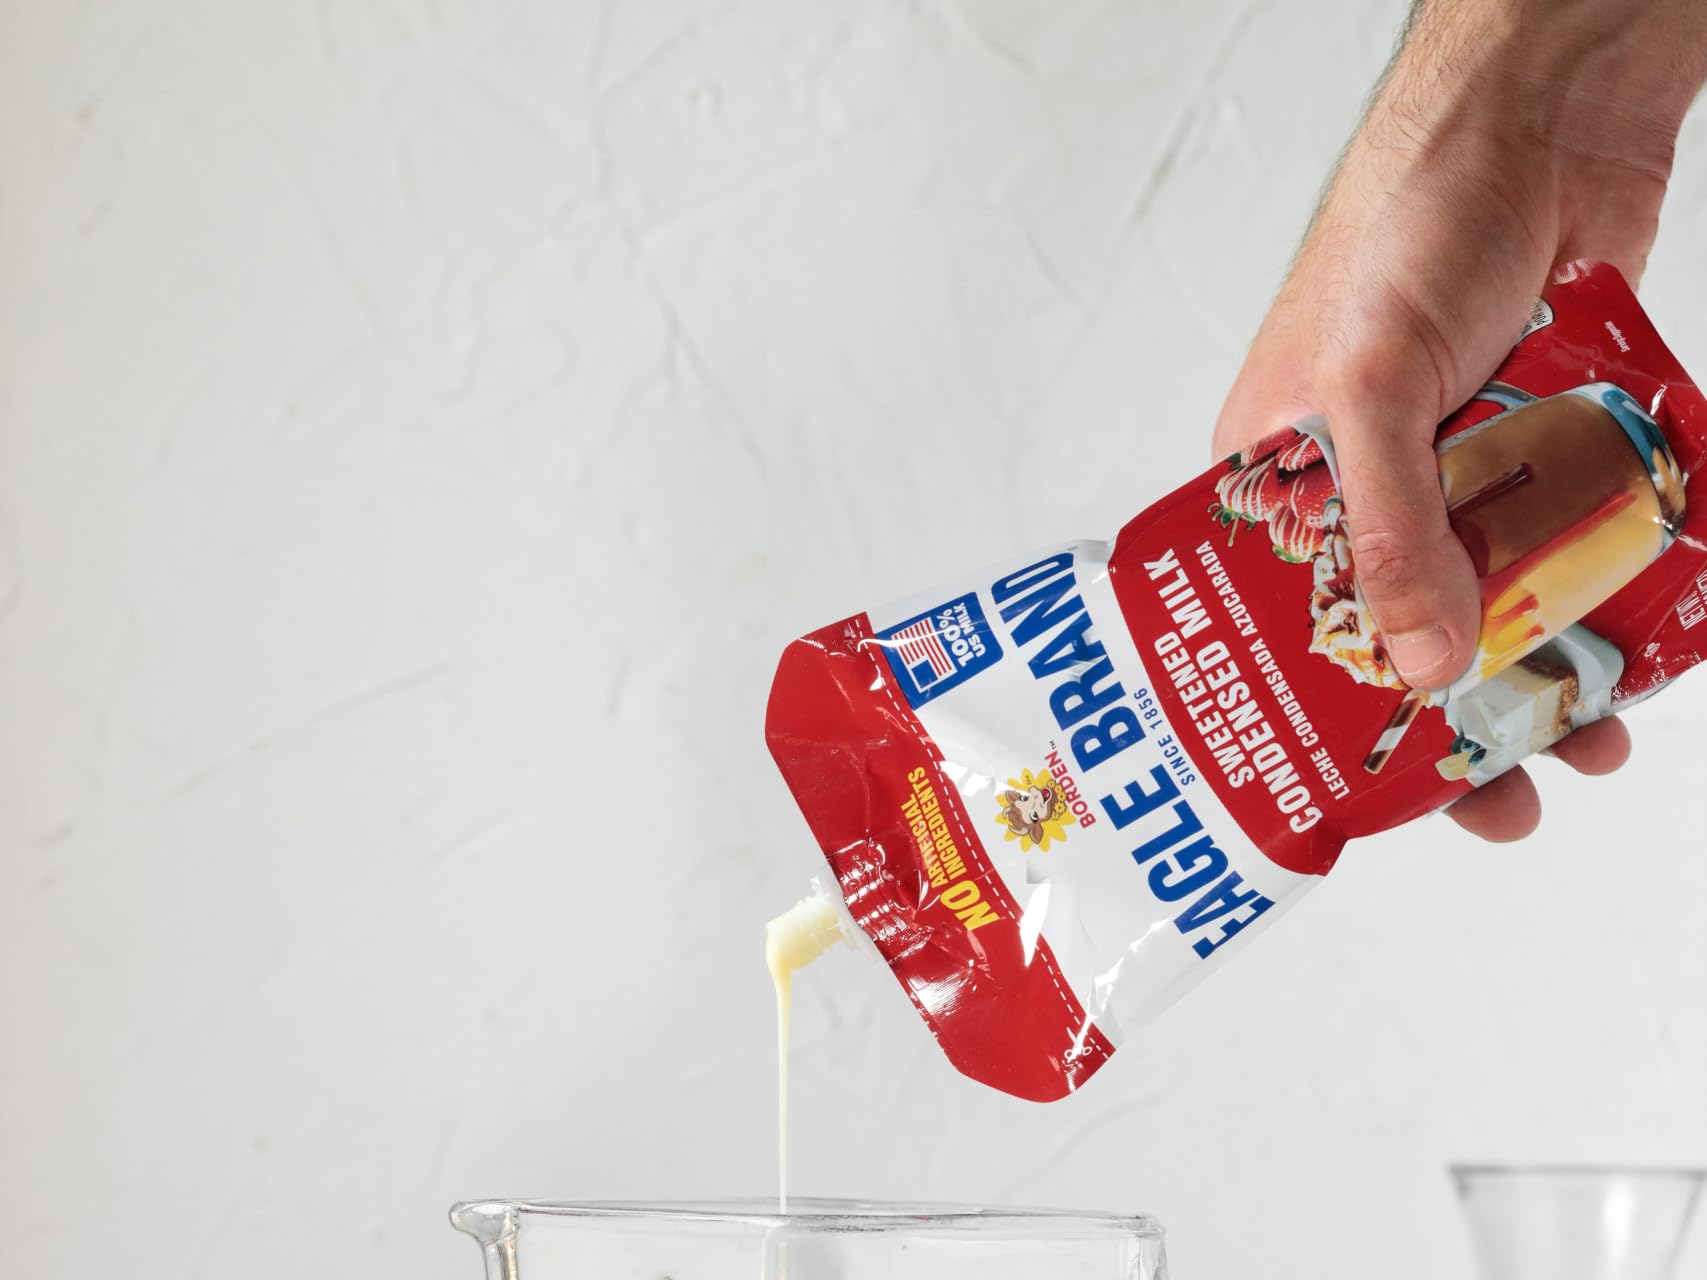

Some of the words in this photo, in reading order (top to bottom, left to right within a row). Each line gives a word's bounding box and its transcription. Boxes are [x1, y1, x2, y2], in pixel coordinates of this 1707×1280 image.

[953, 602, 975, 635] MILK
[1143, 549, 1213, 640] MILK
[1195, 540, 1258, 637] AZUCARADA
[936, 608, 974, 667] 100%
[967, 634, 986, 657] US
[991, 552, 1146, 773] BRAND
[1134, 688, 1163, 730] 1856
[1154, 632, 1255, 789] SWEETENED
[1195, 640, 1323, 834] CONDENSED
[1249, 637, 1319, 747] CONDENSADA
[1157, 734, 1196, 786] SINCE
[1310, 747, 1350, 800] LECHE
[901, 794, 949, 889] ARTIFICIAL
[907, 766, 968, 880] INGREDIENTS
[1100, 764, 1276, 960] EAGLE
[940, 879, 1000, 932] NO
